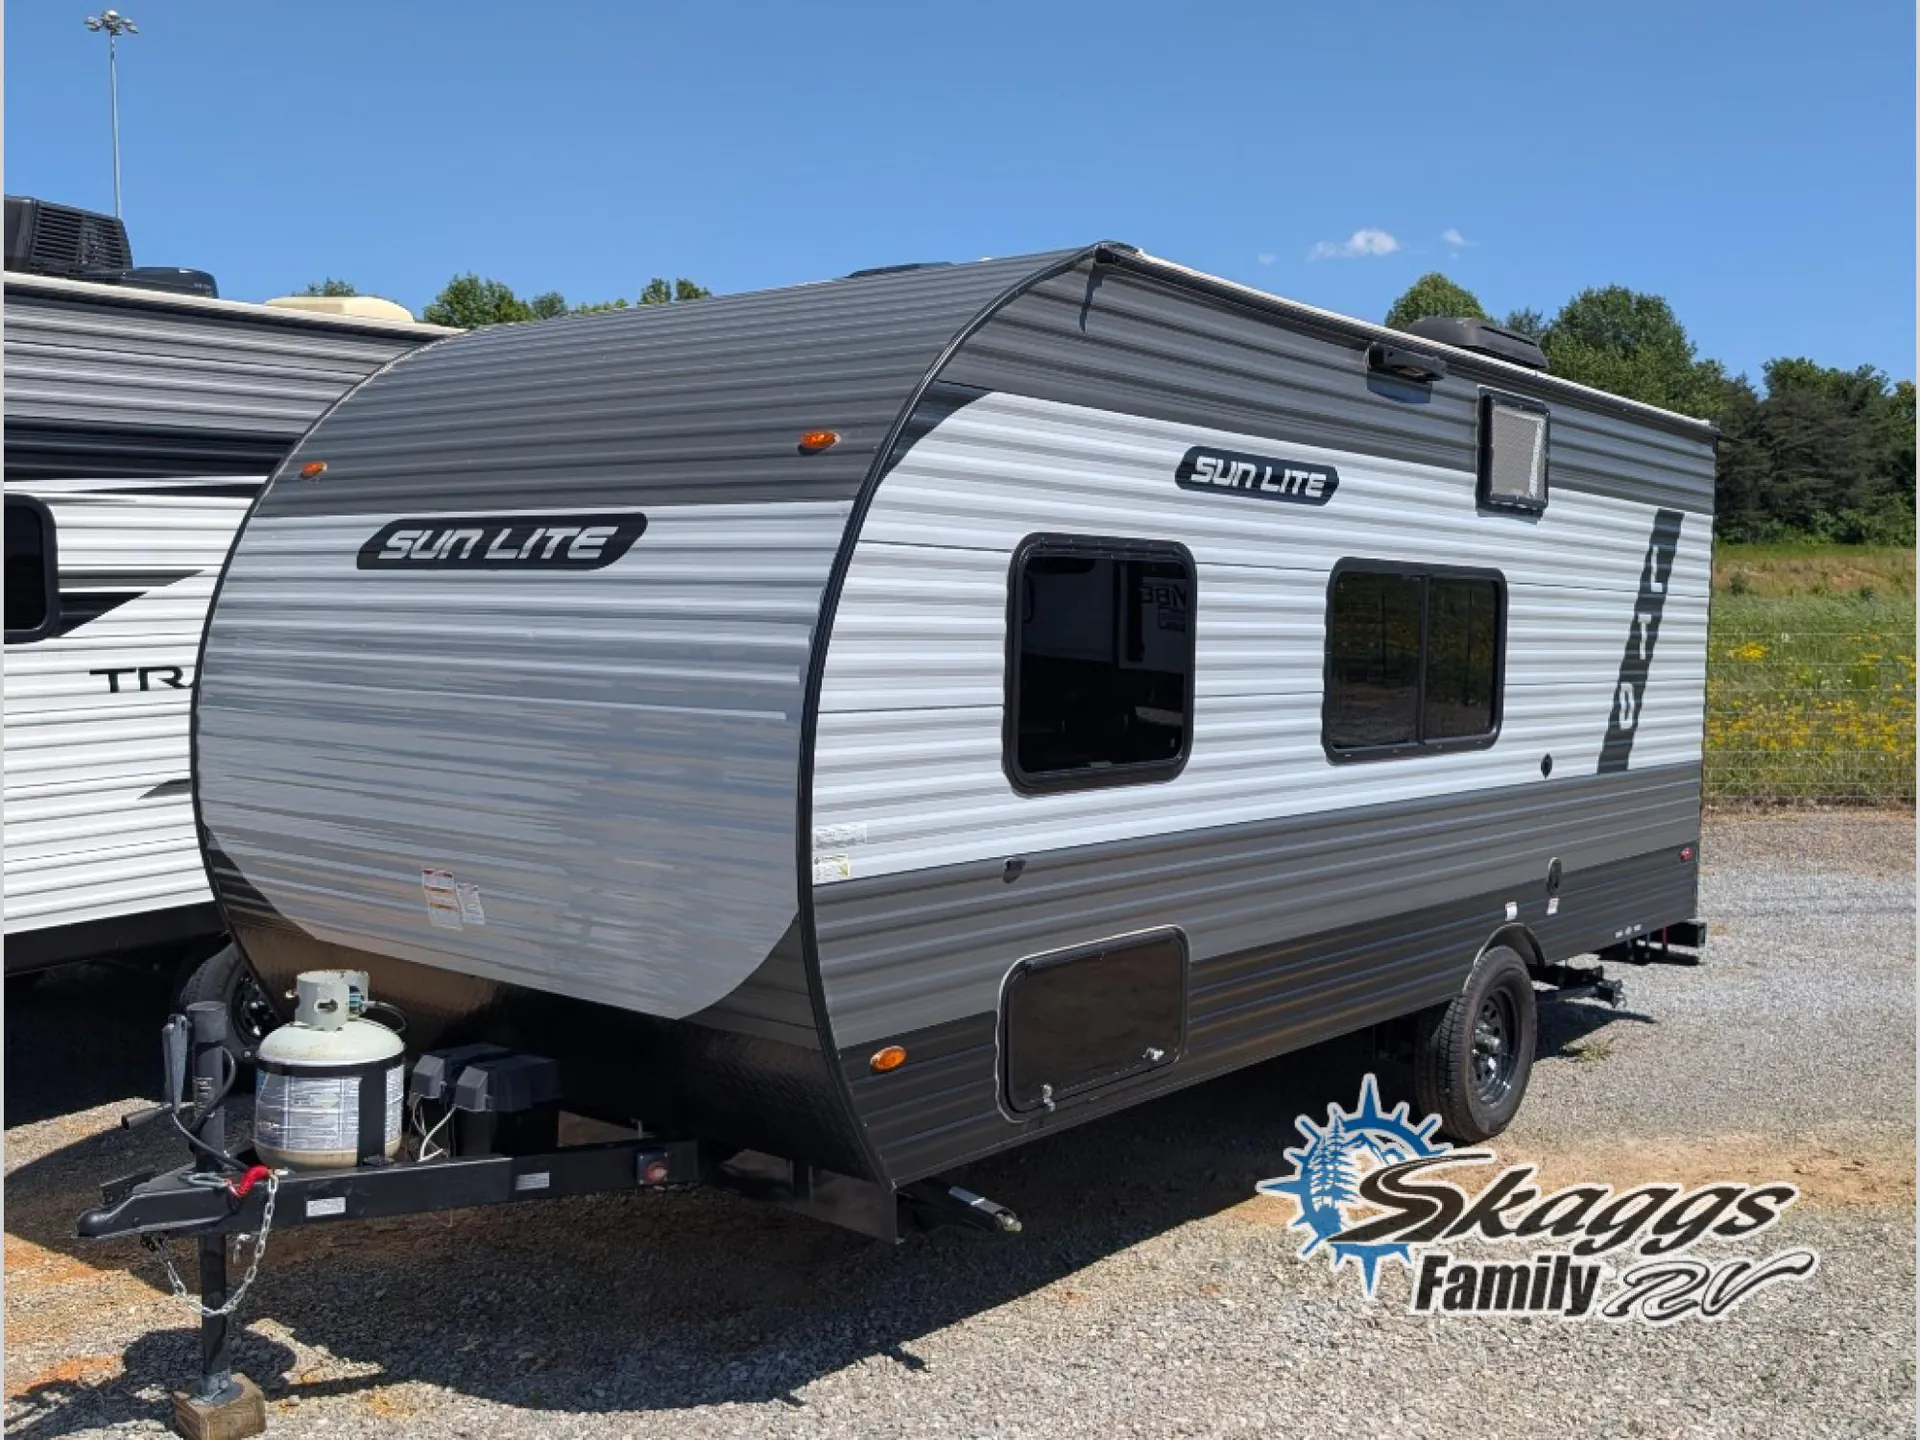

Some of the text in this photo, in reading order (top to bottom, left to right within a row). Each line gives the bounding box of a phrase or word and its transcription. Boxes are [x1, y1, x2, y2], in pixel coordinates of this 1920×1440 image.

[1191, 455, 1327, 498] SUN LITE
[377, 526, 619, 560] SUN LITE
[89, 666, 193, 693] TR
